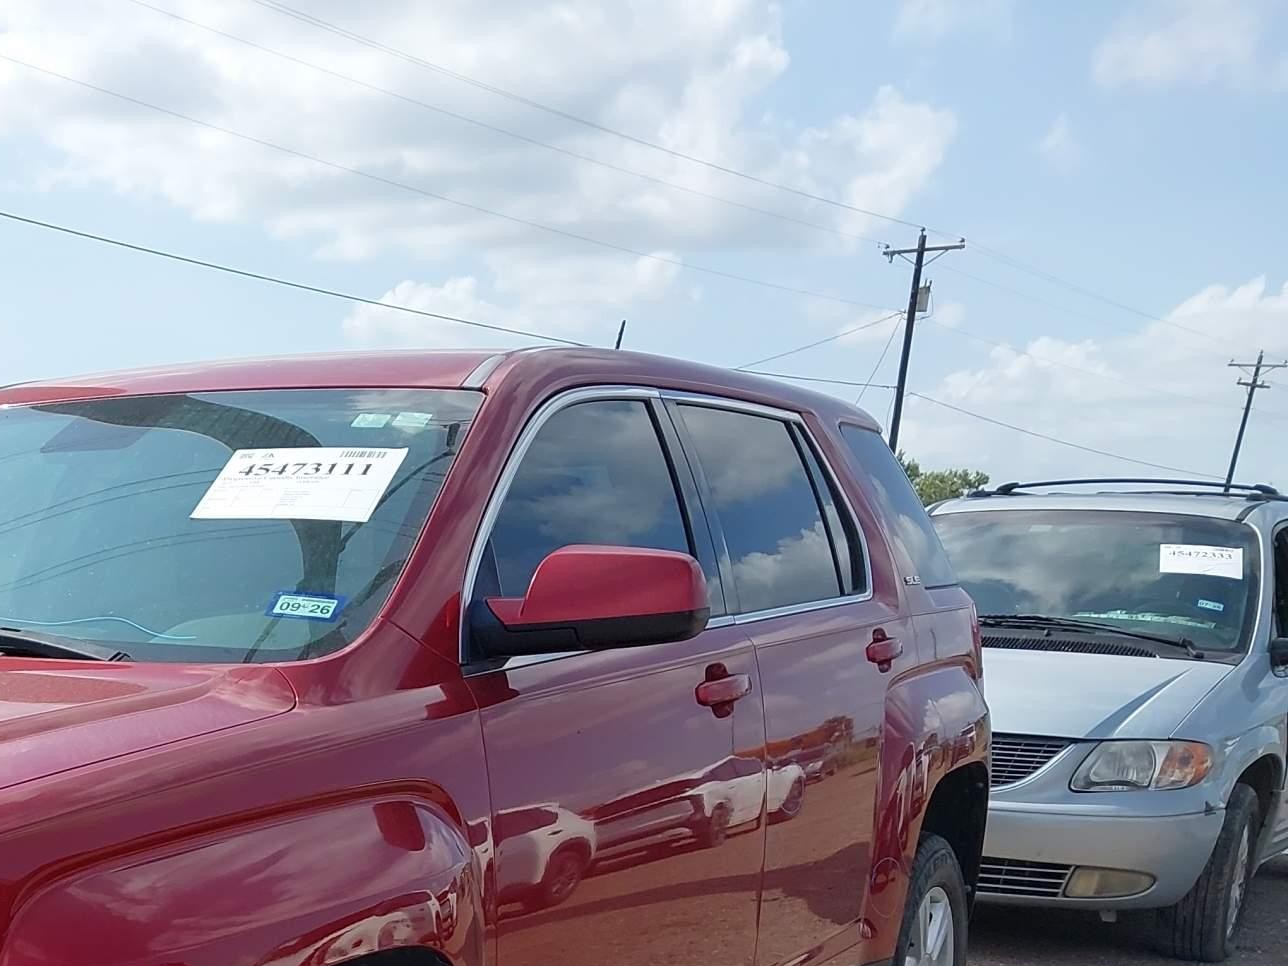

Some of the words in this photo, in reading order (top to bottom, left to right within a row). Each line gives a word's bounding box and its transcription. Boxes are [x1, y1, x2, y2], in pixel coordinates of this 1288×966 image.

[238, 462, 374, 477] 45473111
[279, 601, 301, 612] 09
[309, 604, 332, 615] 26
